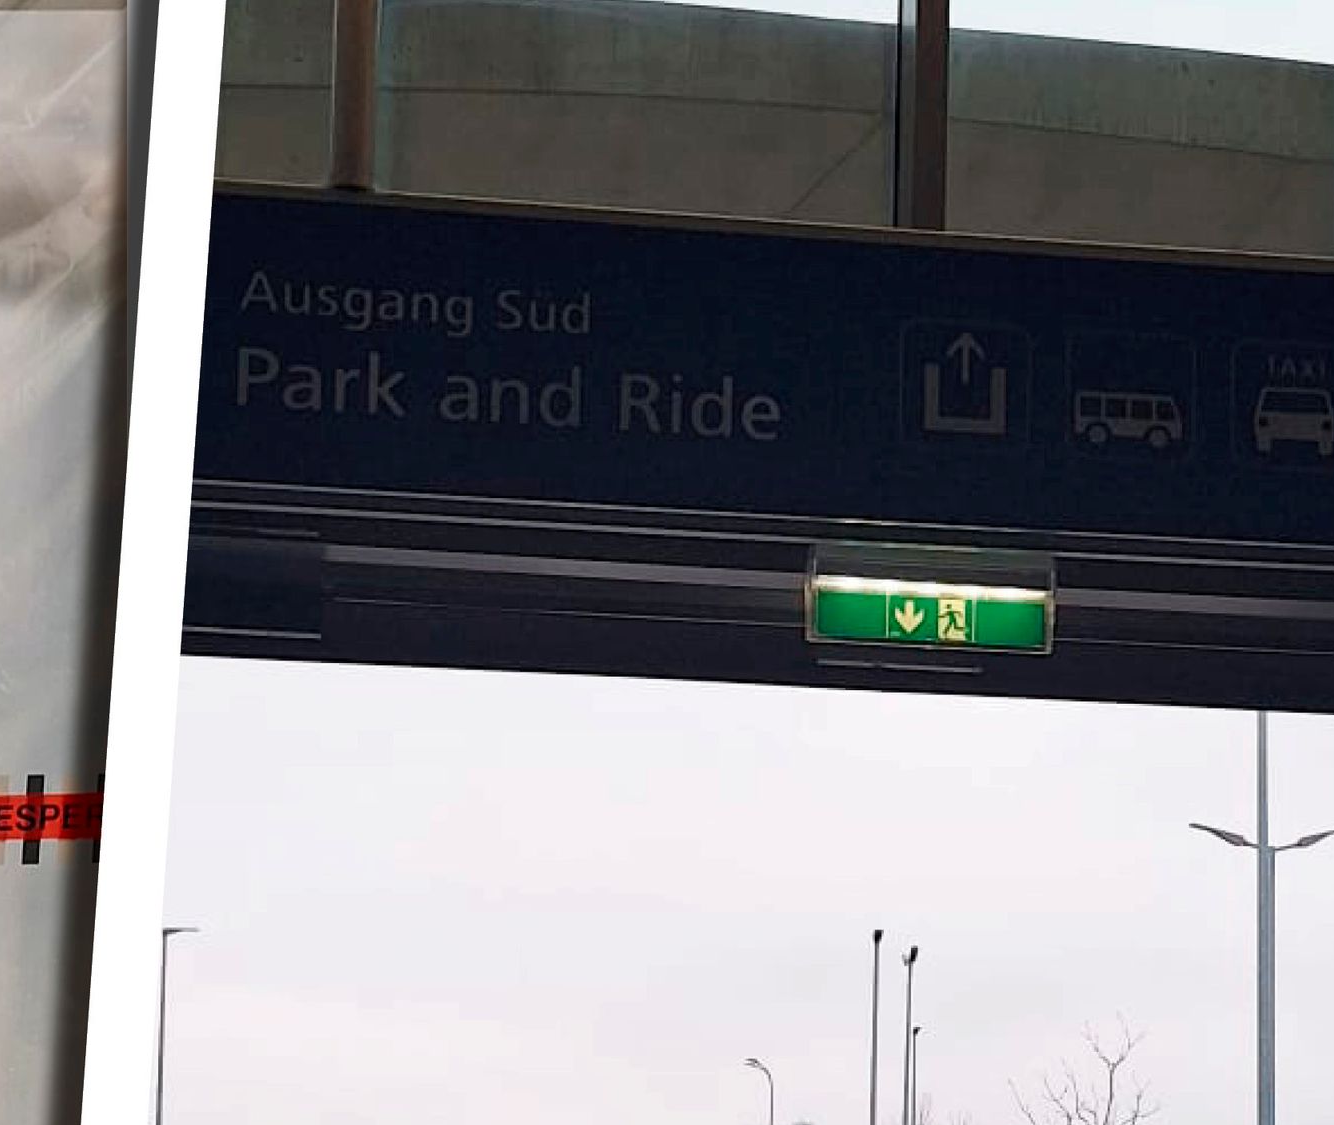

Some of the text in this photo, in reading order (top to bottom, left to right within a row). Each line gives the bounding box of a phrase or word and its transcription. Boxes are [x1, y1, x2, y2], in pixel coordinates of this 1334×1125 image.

[240, 269, 473, 337] Ausgang
[234, 346, 782, 441] Park and Ride
[1266, 355, 1327, 380] TAXI
